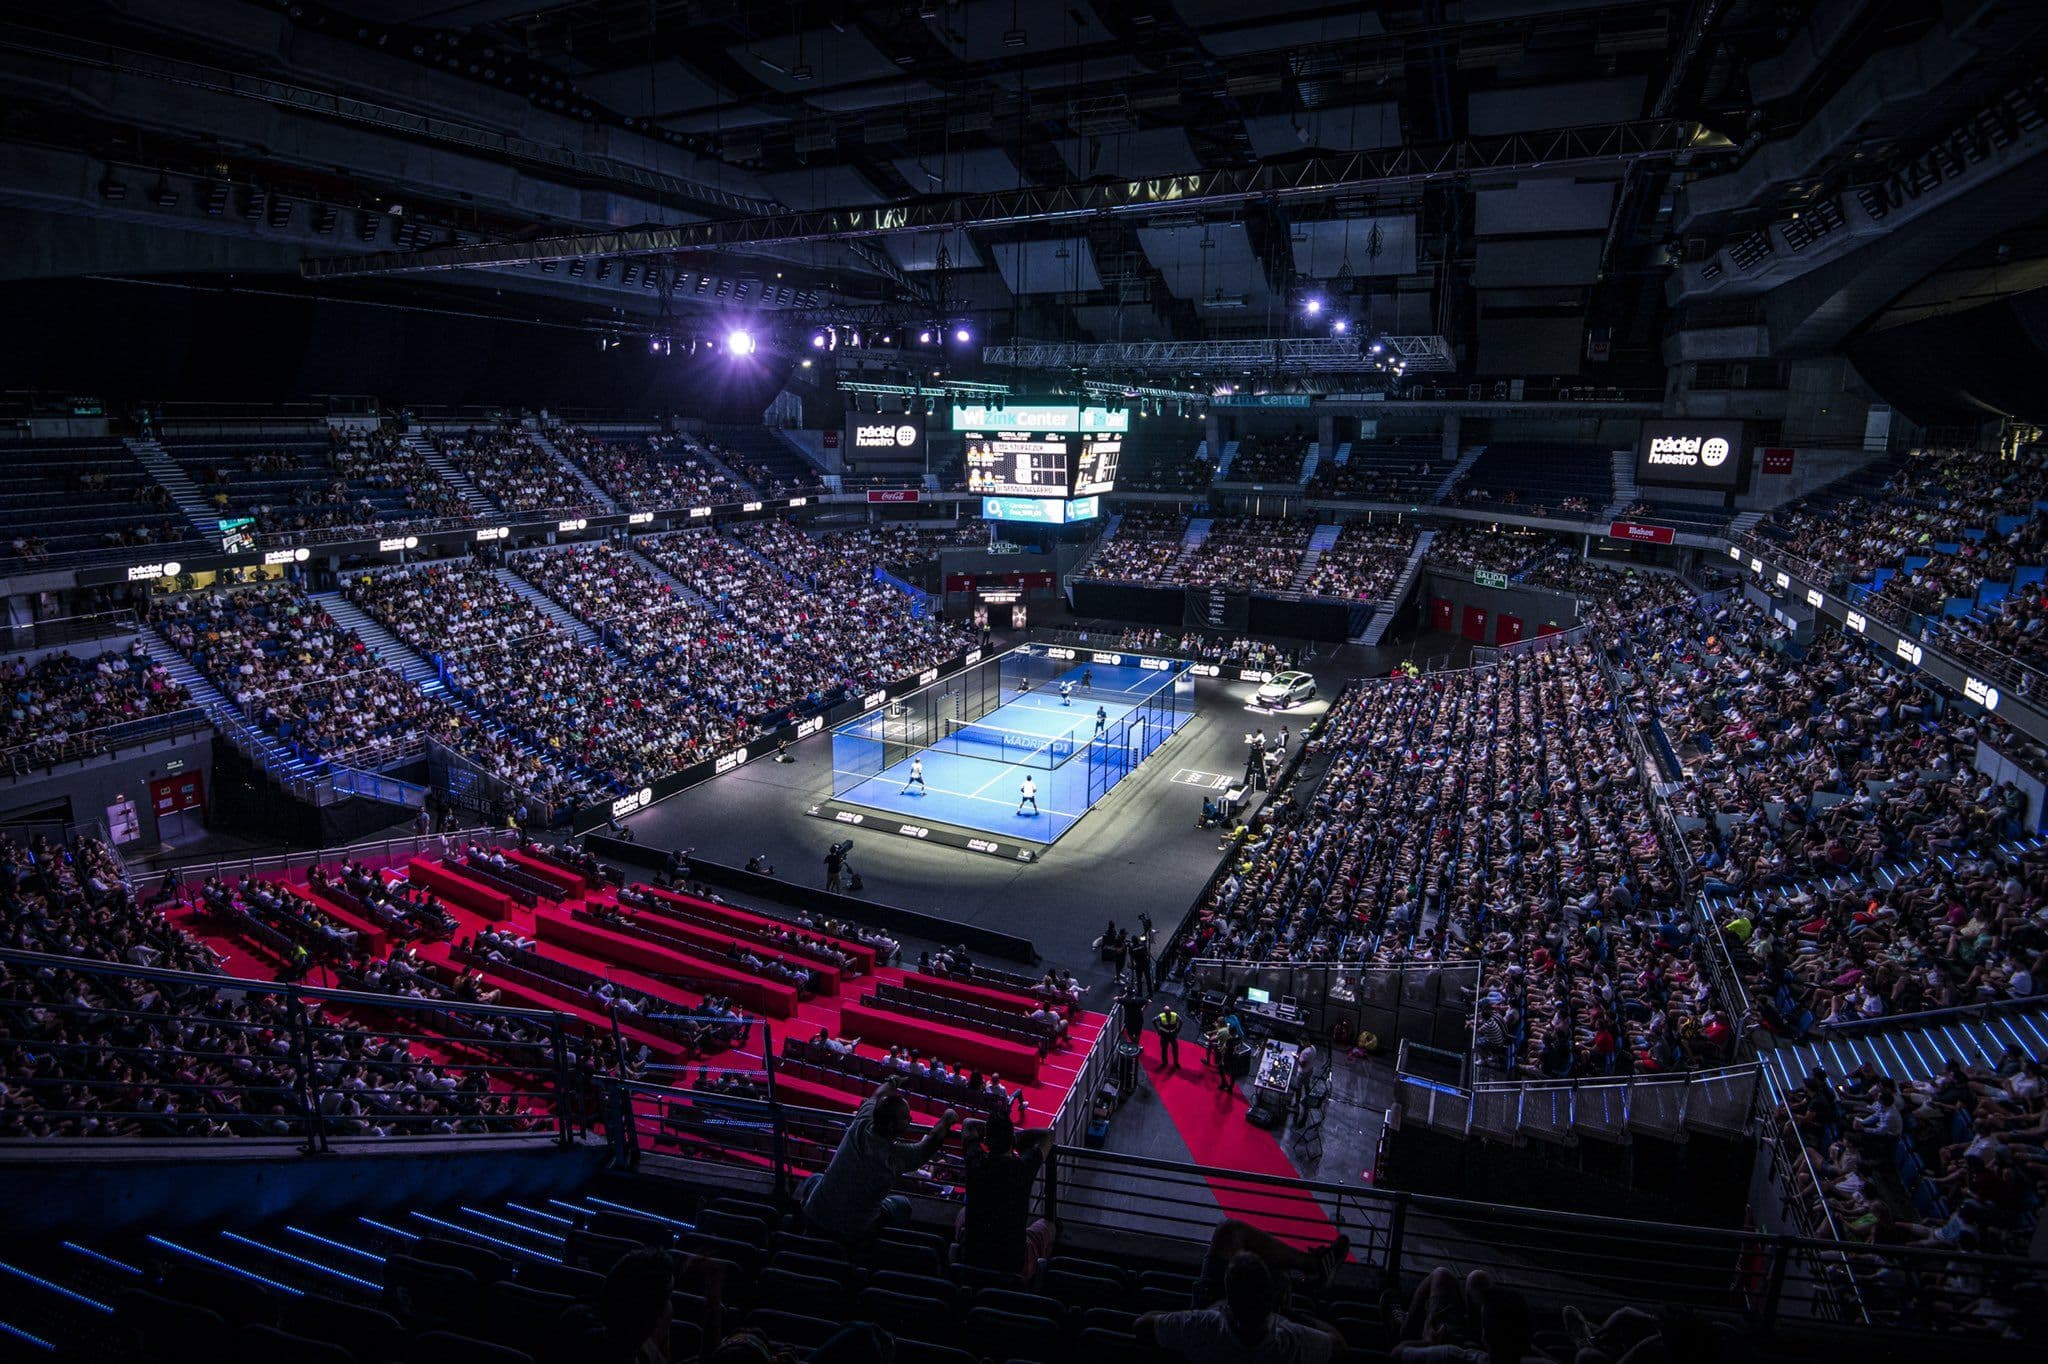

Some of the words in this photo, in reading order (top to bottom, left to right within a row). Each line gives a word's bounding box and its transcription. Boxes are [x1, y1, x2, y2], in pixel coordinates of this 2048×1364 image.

[857, 425, 896, 439] pádel
[1651, 437, 1702, 454] pádel
[1648, 451, 1698, 466] nuestro
[1476, 570, 1504, 582] SALIDA
[1003, 734, 1048, 751] MADRID
